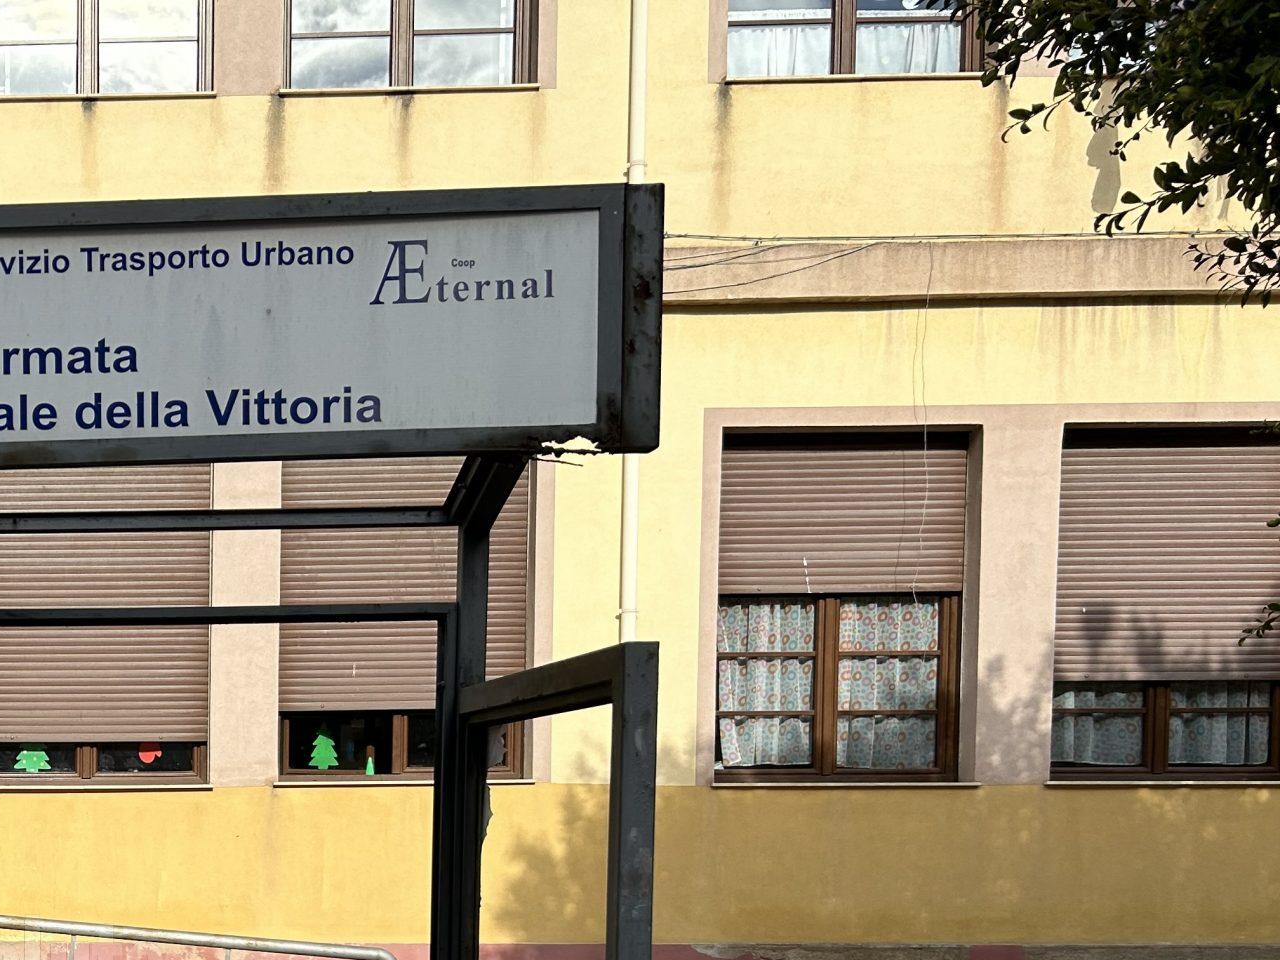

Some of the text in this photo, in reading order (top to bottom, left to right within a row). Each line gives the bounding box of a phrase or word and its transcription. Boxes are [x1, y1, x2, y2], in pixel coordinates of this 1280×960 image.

[79, 243, 230, 277] Trasporto
[241, 240, 355, 267] Urbano
[451, 258, 476, 269] Coop
[75, 390, 189, 430] della
[205, 386, 383, 427] Vittoria
